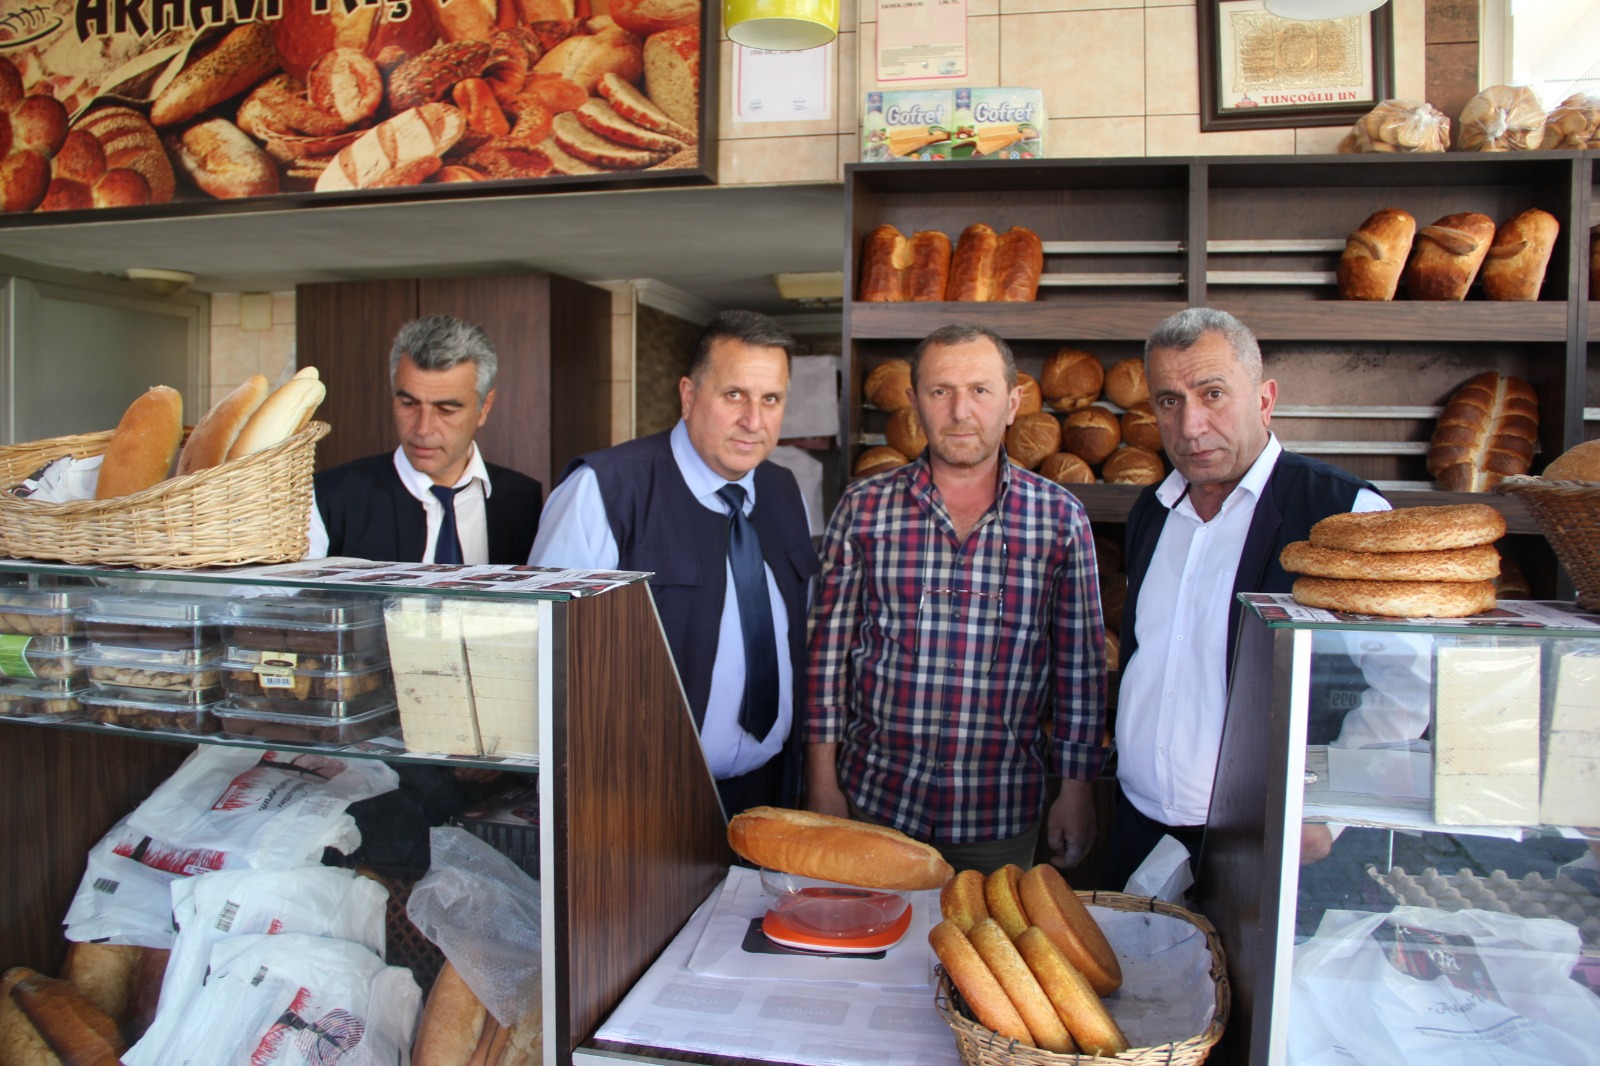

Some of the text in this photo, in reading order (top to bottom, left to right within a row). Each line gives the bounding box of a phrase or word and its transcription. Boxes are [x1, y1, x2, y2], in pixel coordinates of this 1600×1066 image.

[1262, 91, 1357, 104] TUNÇOĞLU UN
[886, 104, 944, 126] Gofret
[974, 101, 1035, 122] Gofret
